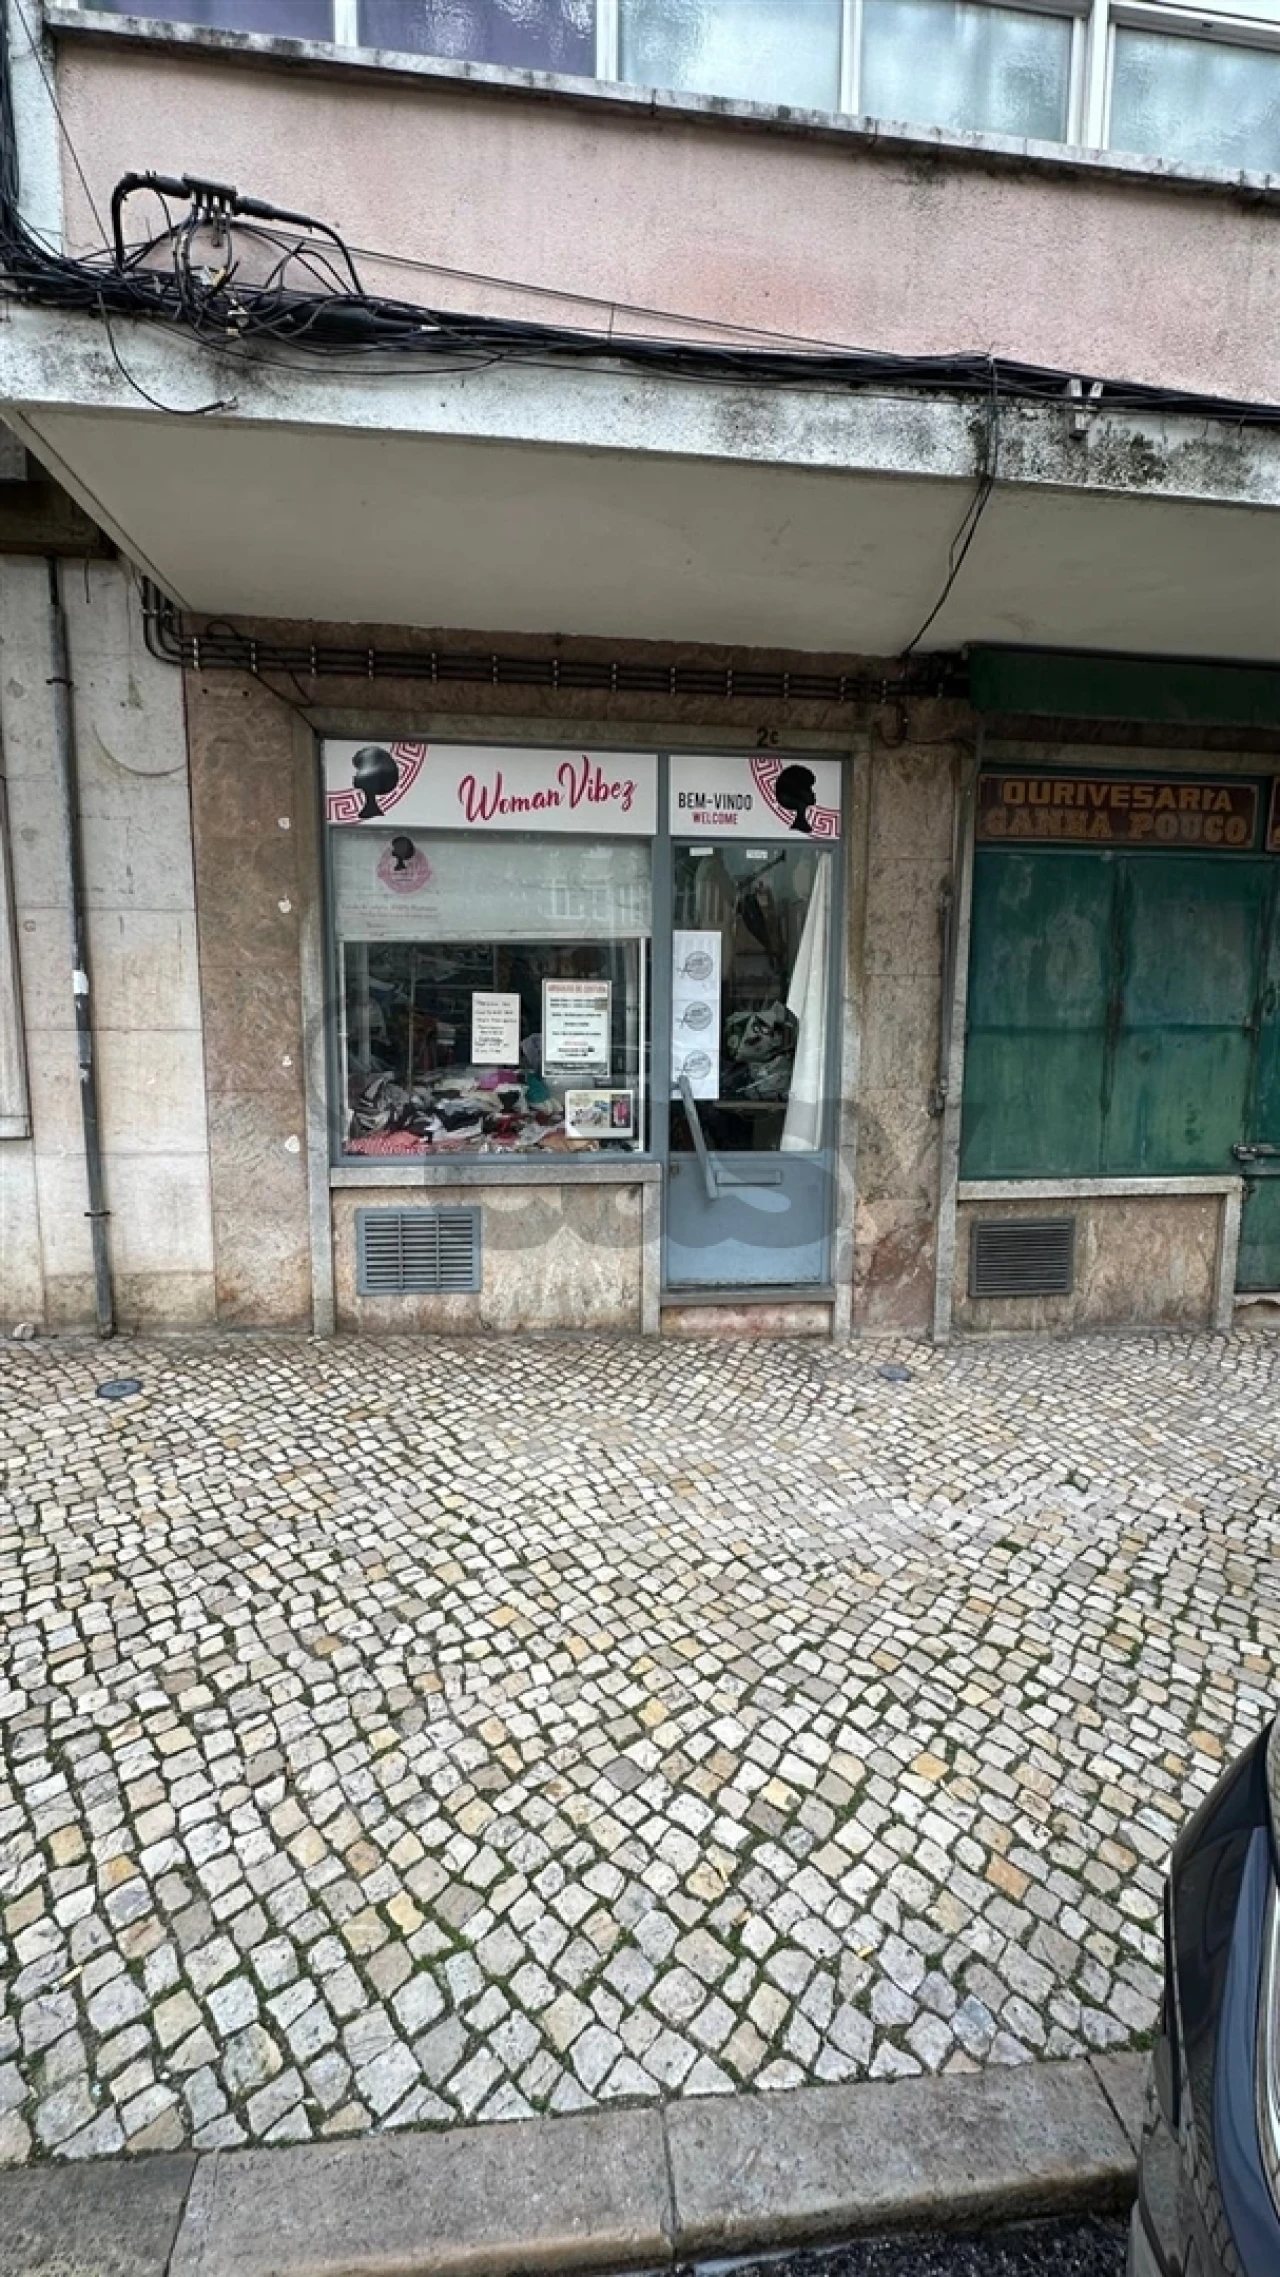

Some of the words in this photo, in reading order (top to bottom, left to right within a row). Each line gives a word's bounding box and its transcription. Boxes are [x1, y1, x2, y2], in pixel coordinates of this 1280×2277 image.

[678, 792, 754, 811] BEM-VINDO
[1002, 780, 1233, 812] OURIVESARIA
[691, 811, 739, 825] WELCOME
